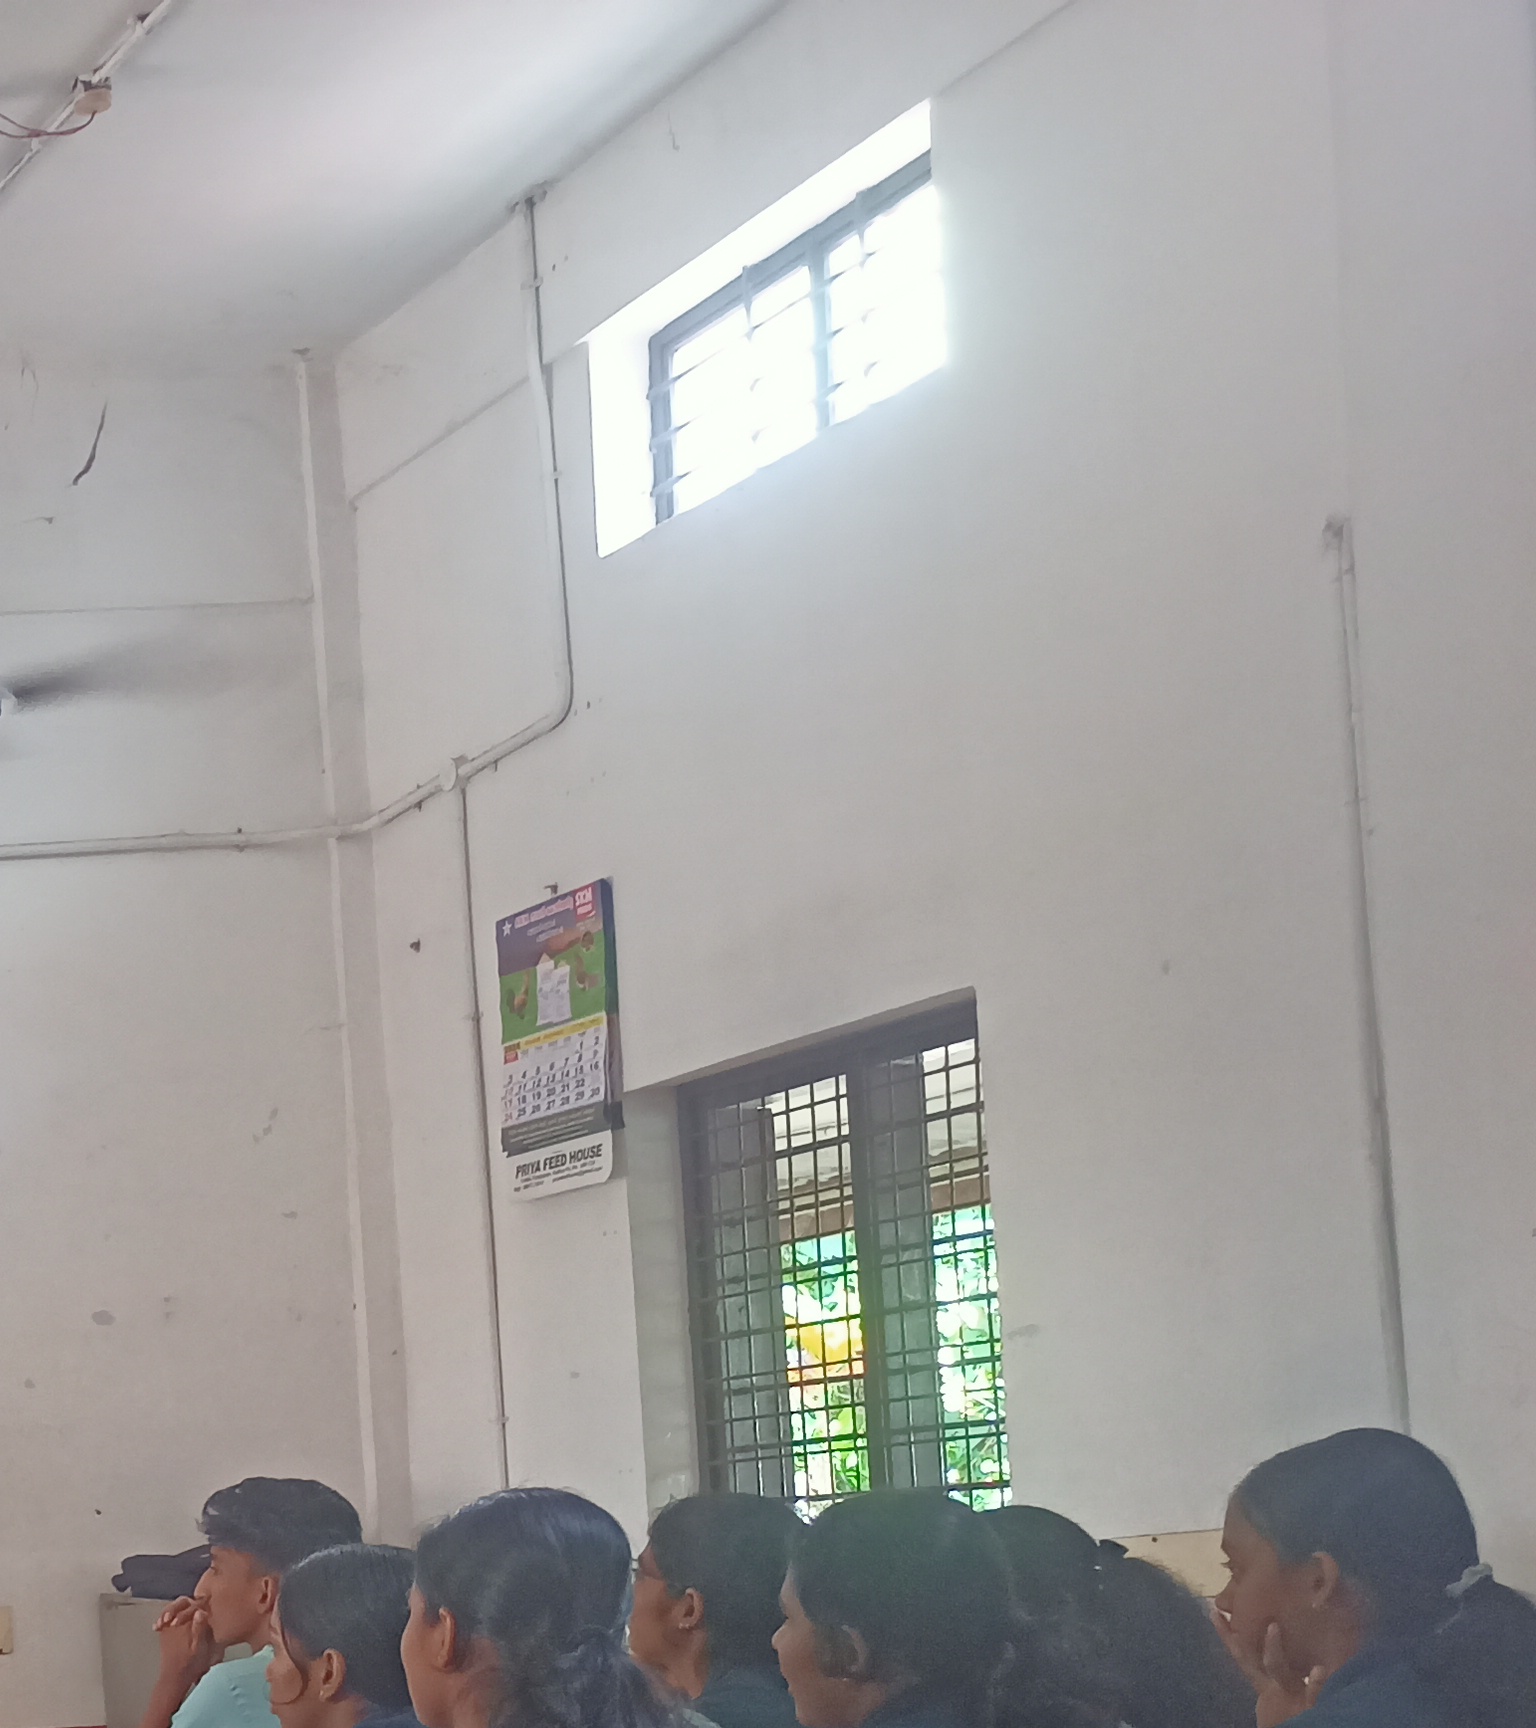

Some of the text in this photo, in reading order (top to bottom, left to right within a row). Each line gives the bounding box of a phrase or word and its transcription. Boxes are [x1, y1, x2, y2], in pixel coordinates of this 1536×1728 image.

[590, 1060, 600, 1072] 16
[532, 1090, 542, 1101] 19
[561, 1082, 570, 1093] 21
[575, 1078, 585, 1089] 22
[515, 1160, 541, 1179] PRIYA
[543, 1153, 567, 1171] FEED
[569, 1143, 603, 1164] HOUSE
